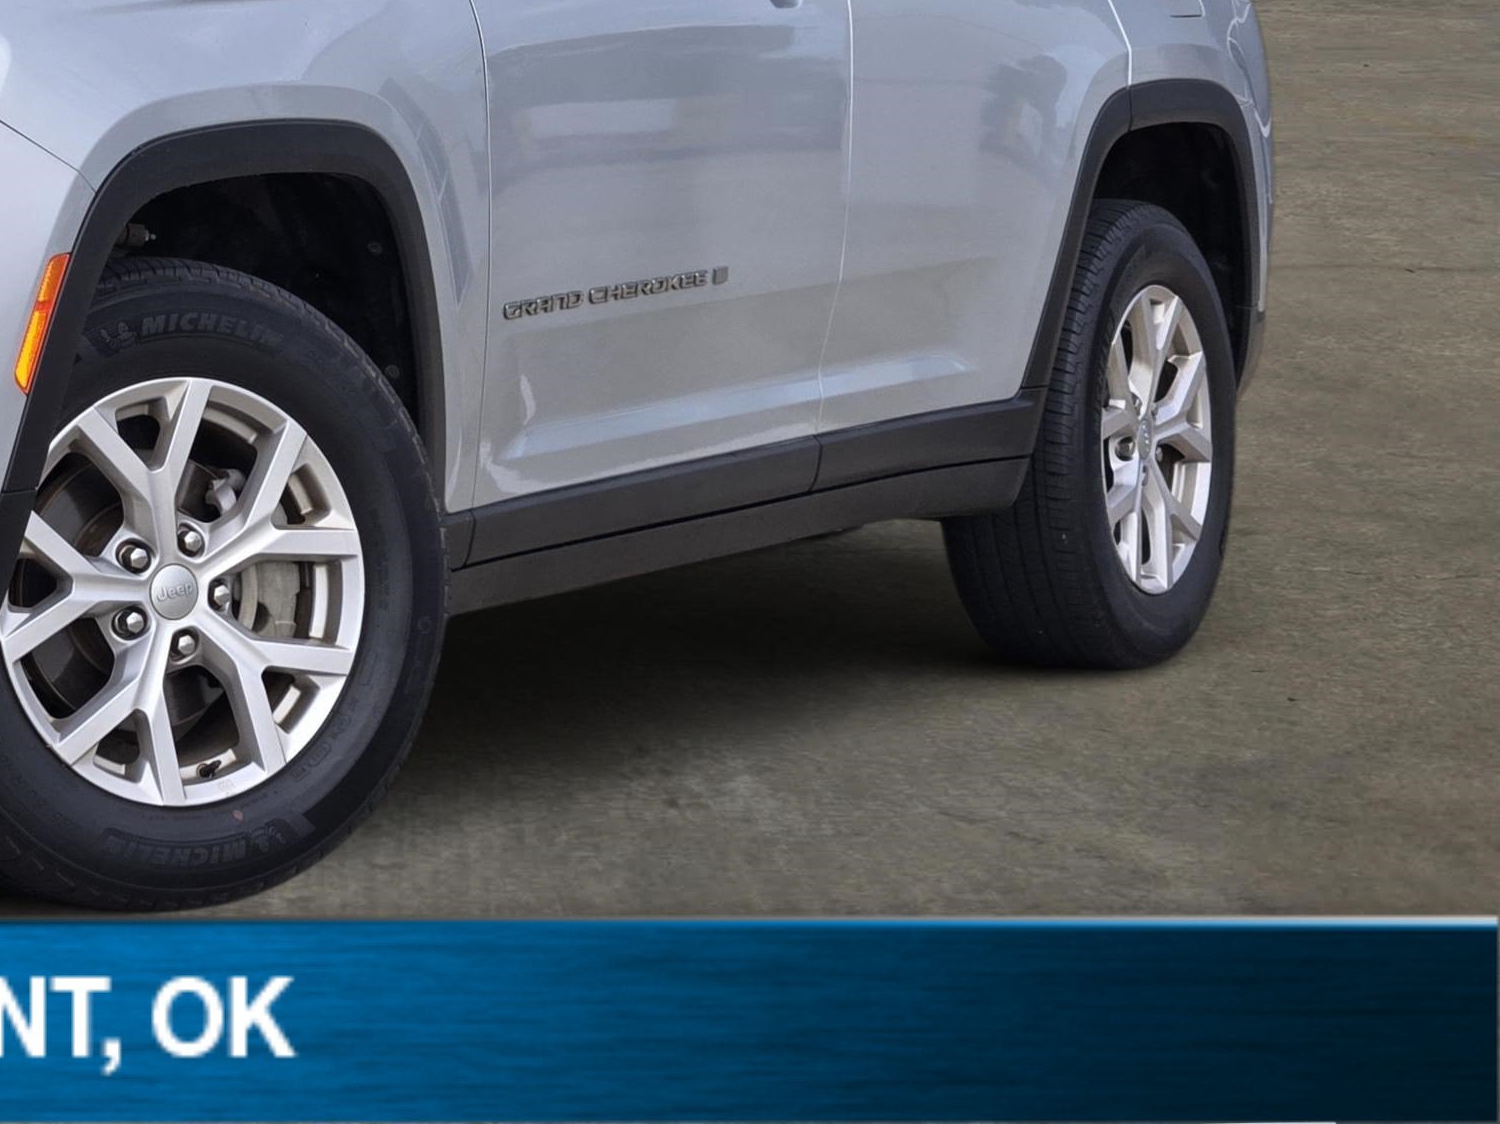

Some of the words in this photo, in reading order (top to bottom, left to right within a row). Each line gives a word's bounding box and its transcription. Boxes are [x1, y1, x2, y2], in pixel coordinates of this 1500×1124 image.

[503, 289, 584, 321] GRAND
[588, 269, 709, 305] CHEROKEE
[141, 312, 285, 348] MICHELIN
[156, 581, 194, 602] Jeep
